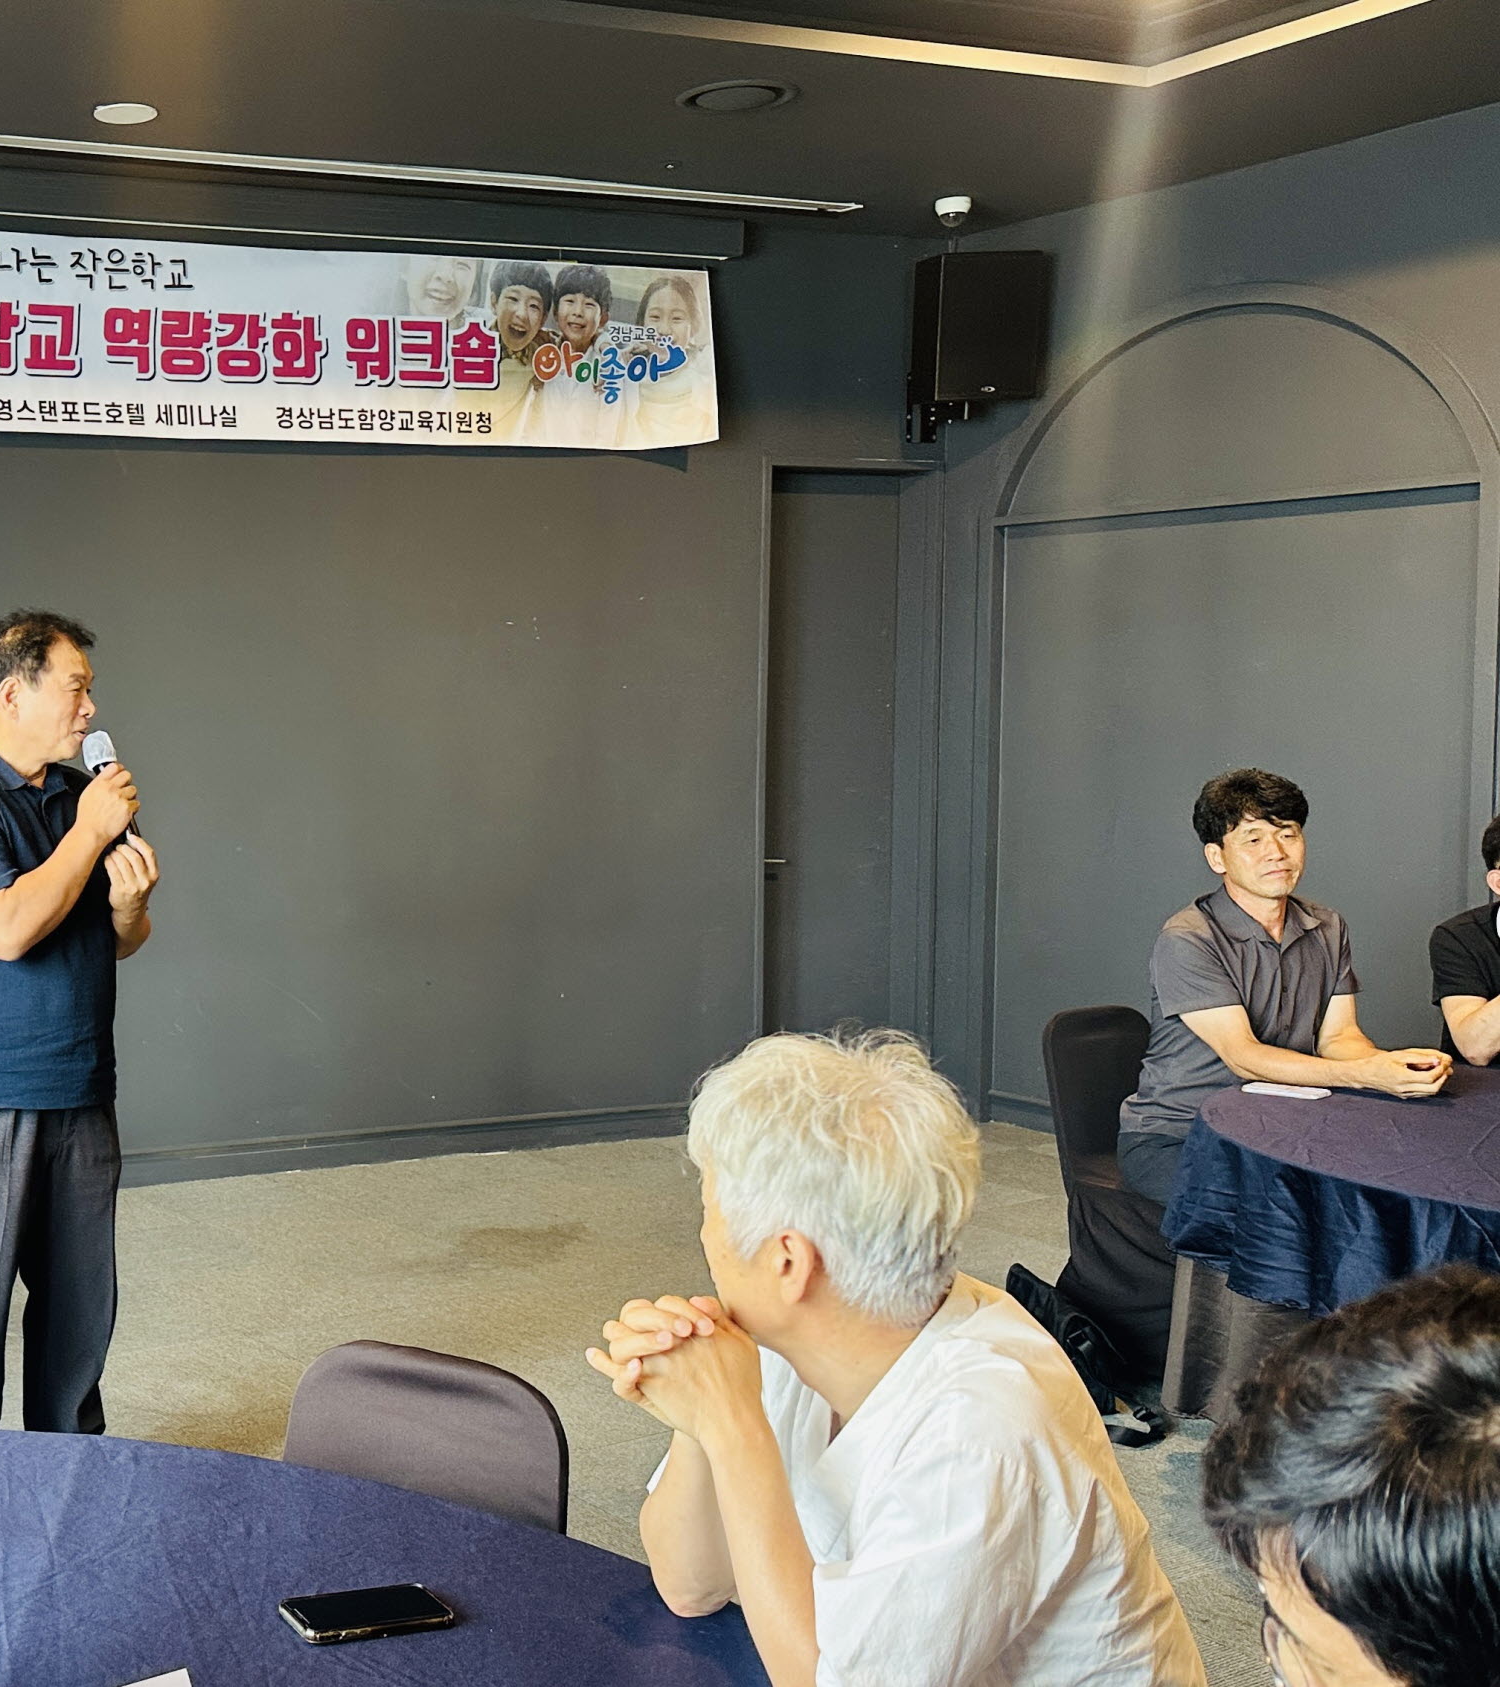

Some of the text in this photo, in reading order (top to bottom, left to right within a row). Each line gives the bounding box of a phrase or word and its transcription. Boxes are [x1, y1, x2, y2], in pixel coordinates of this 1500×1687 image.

[69, 247, 194, 290] 작은학교
[103, 305, 328, 385] 역량강화
[346, 317, 500, 389] 워크숍
[609, 326, 657, 345] 경남교육
[533, 342, 687, 404] 아이좋아
[155, 403, 238, 428] 세미나실
[275, 407, 493, 434] 경상남도함양교육지원청
